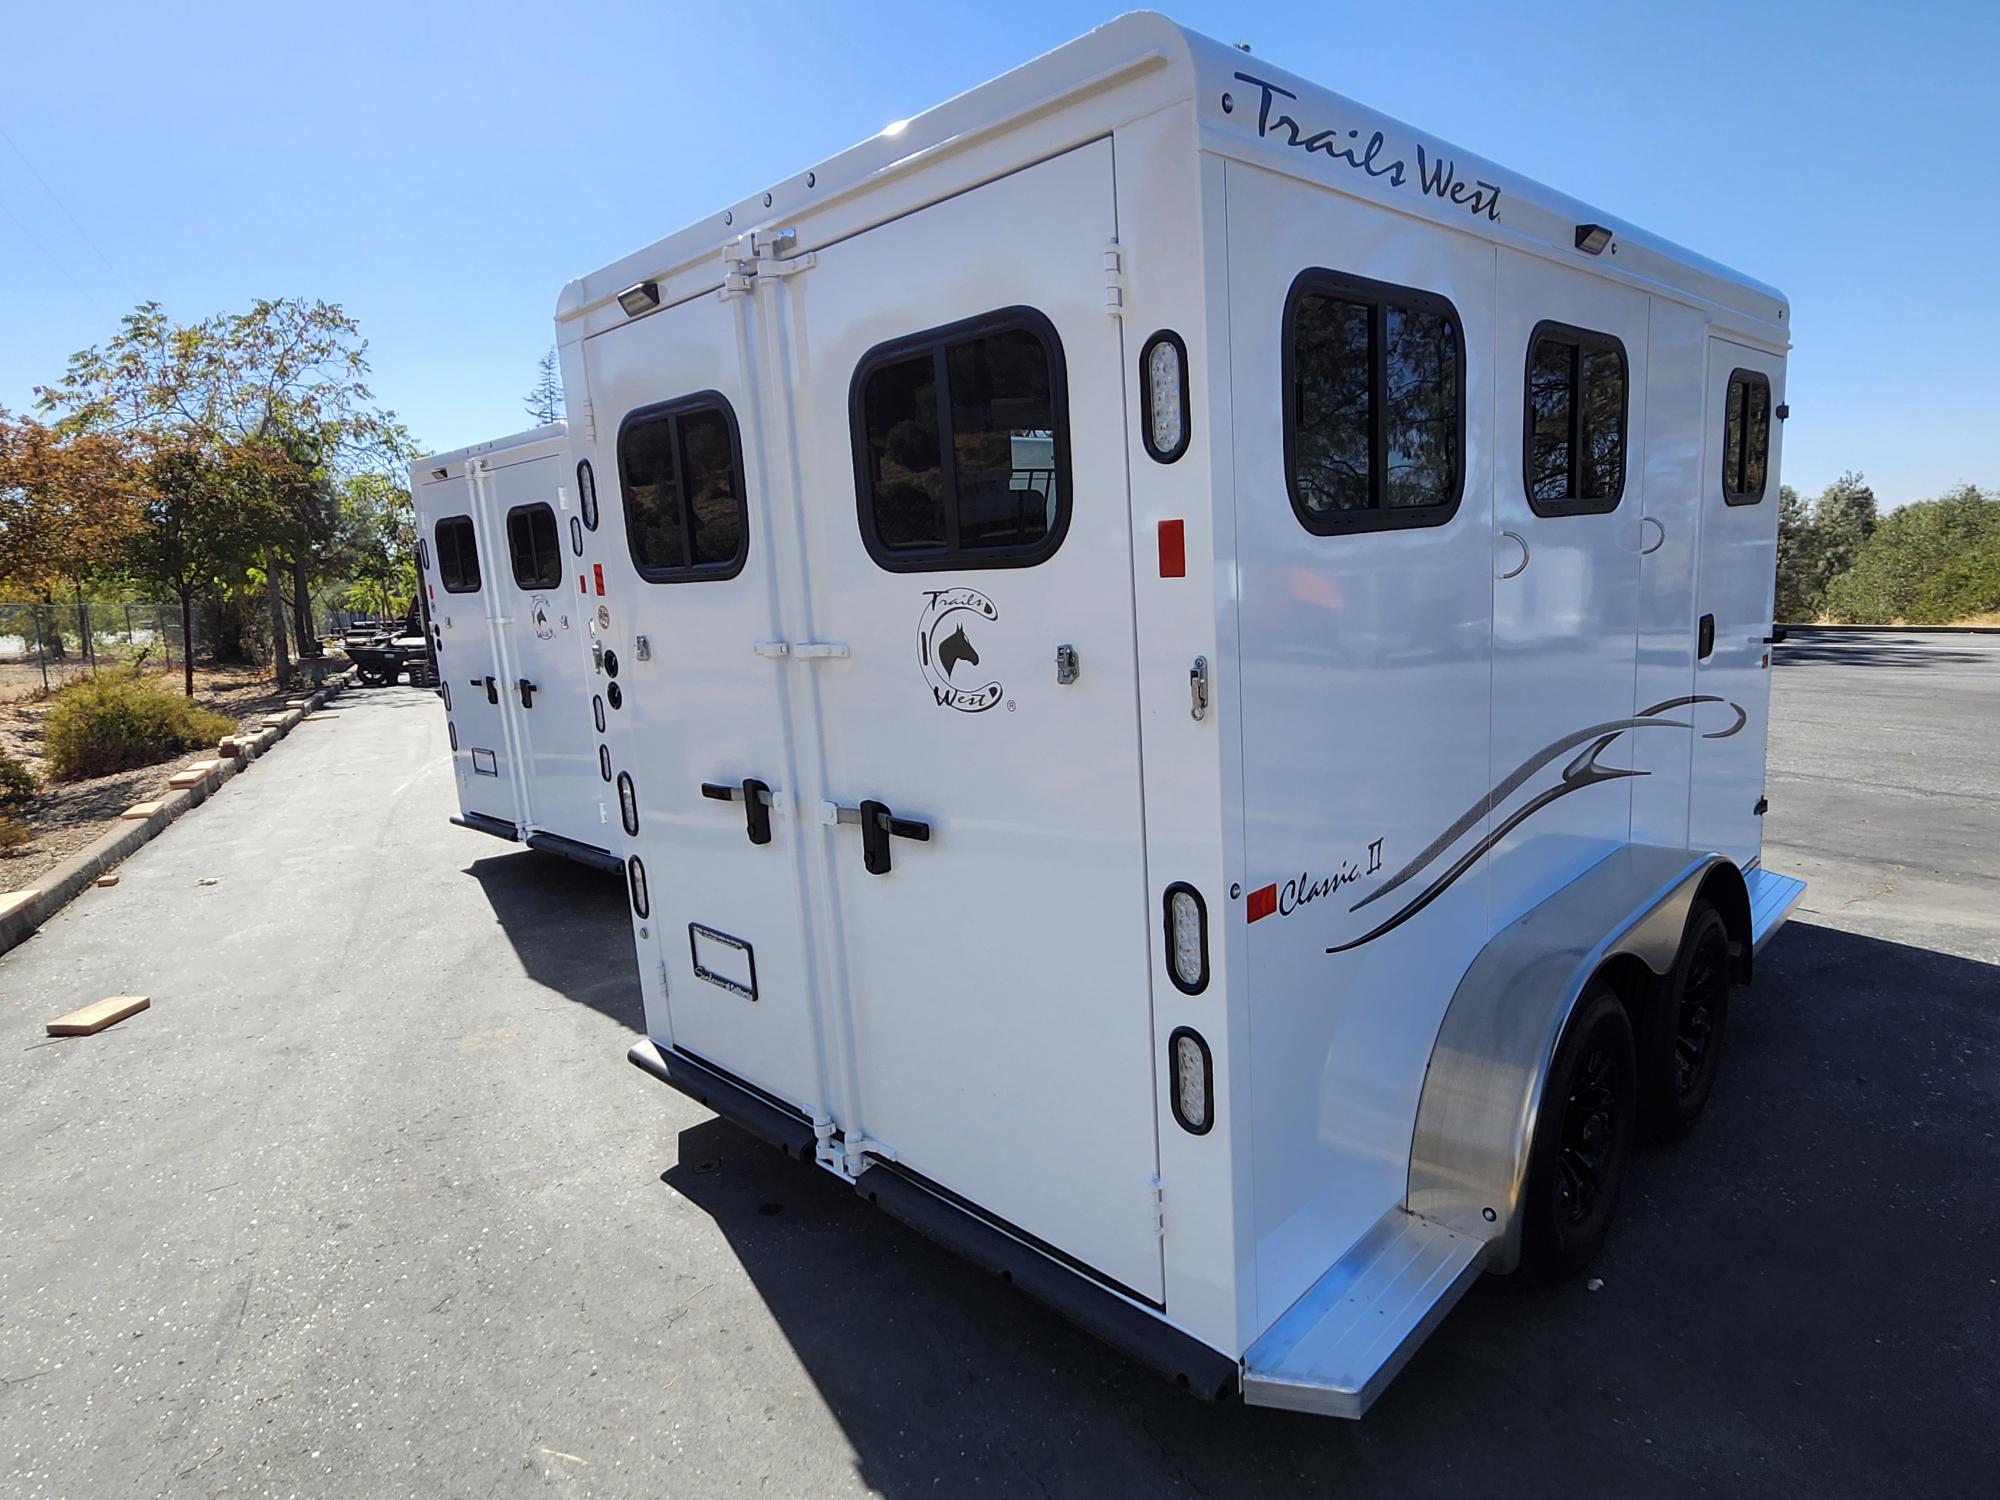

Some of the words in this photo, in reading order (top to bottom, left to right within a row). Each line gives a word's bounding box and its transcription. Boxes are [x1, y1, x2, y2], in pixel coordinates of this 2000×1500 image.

[1234, 71, 1406, 186] Trails
[1416, 144, 1500, 221] West
[922, 590, 982, 611] Trails
[934, 686, 986, 706] West
[1279, 860, 1360, 916] Classic
[1366, 836, 1384, 875] II
